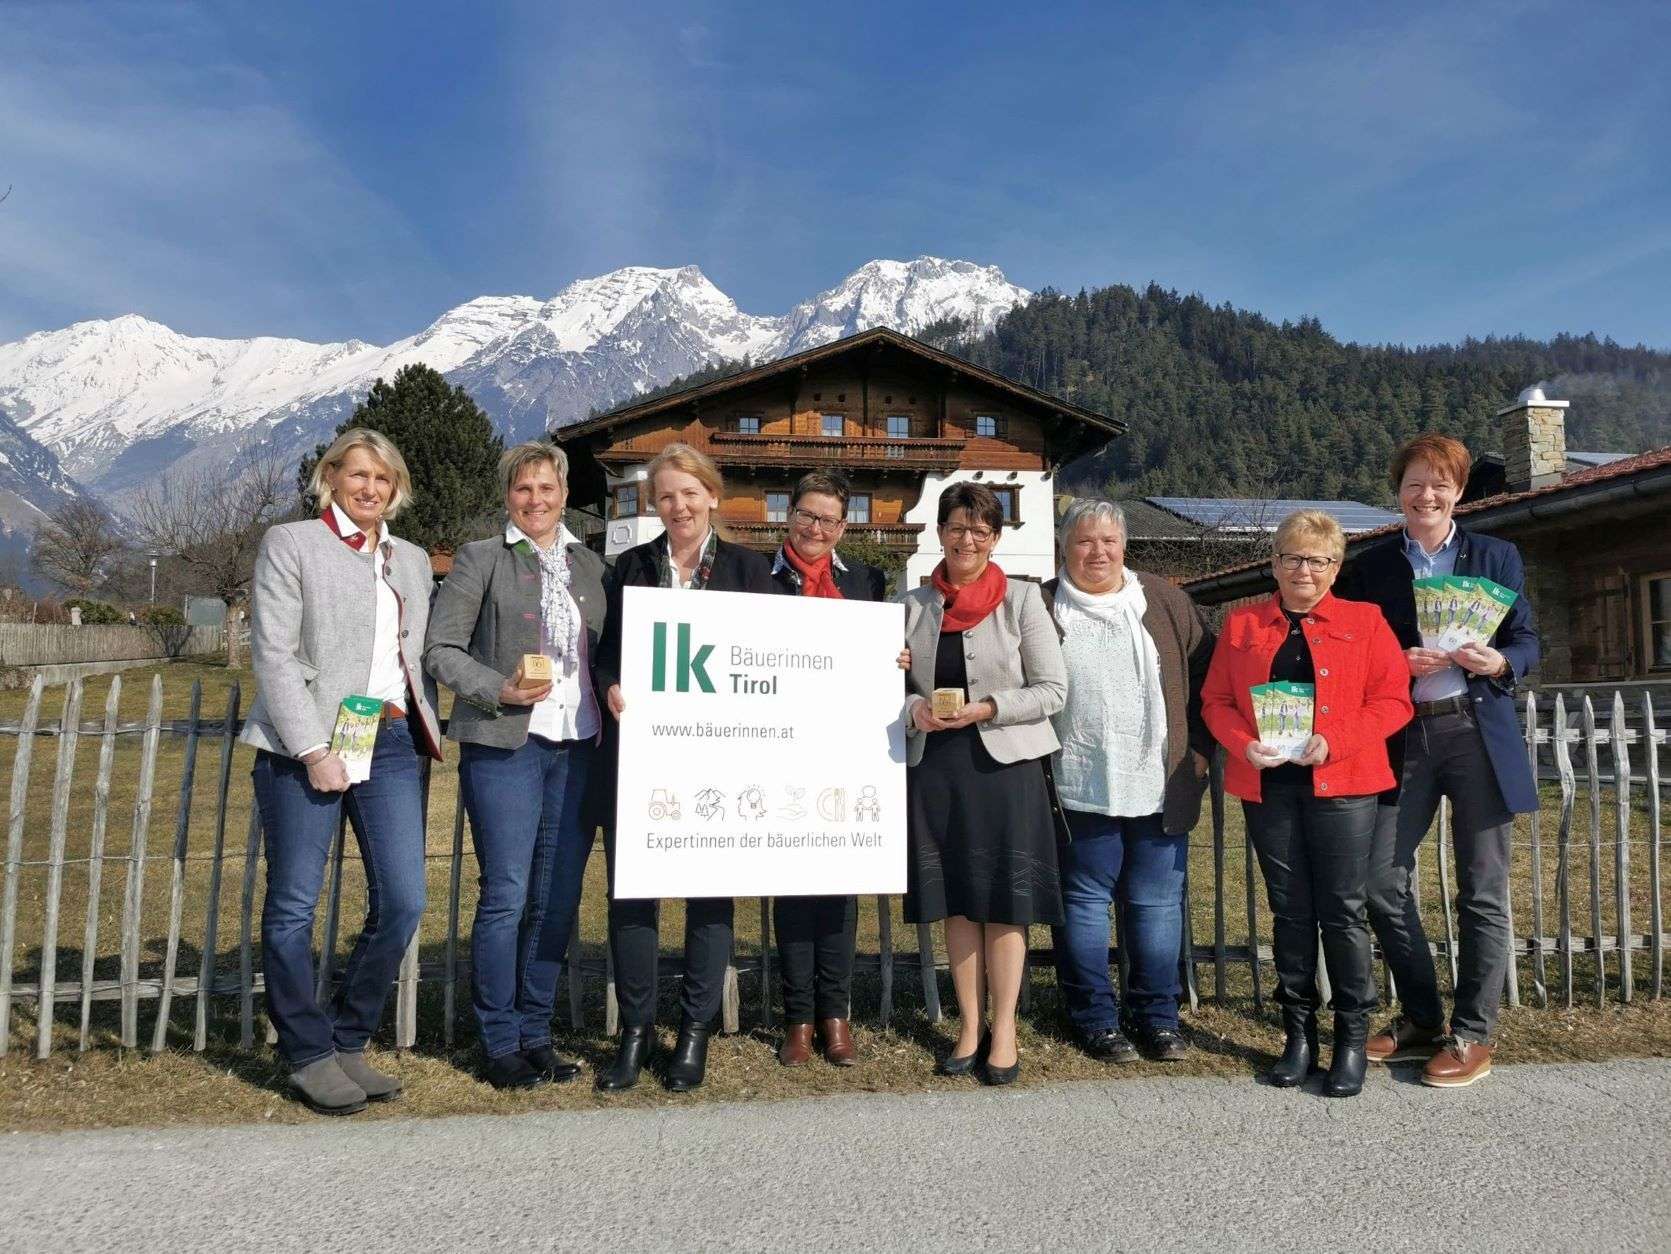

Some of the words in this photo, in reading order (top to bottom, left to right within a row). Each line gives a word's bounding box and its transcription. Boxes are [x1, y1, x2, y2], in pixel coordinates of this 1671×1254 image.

[651, 622, 717, 694] lk
[730, 645, 833, 670] Bäuerinnen
[729, 673, 777, 695] Tirol
[651, 722, 794, 739] www.bäuerinnen.at
[646, 832, 735, 852] Expertinnen
[740, 832, 762, 848] der
[767, 831, 846, 848] bäuerlichen
[851, 831, 882, 848] Welt
